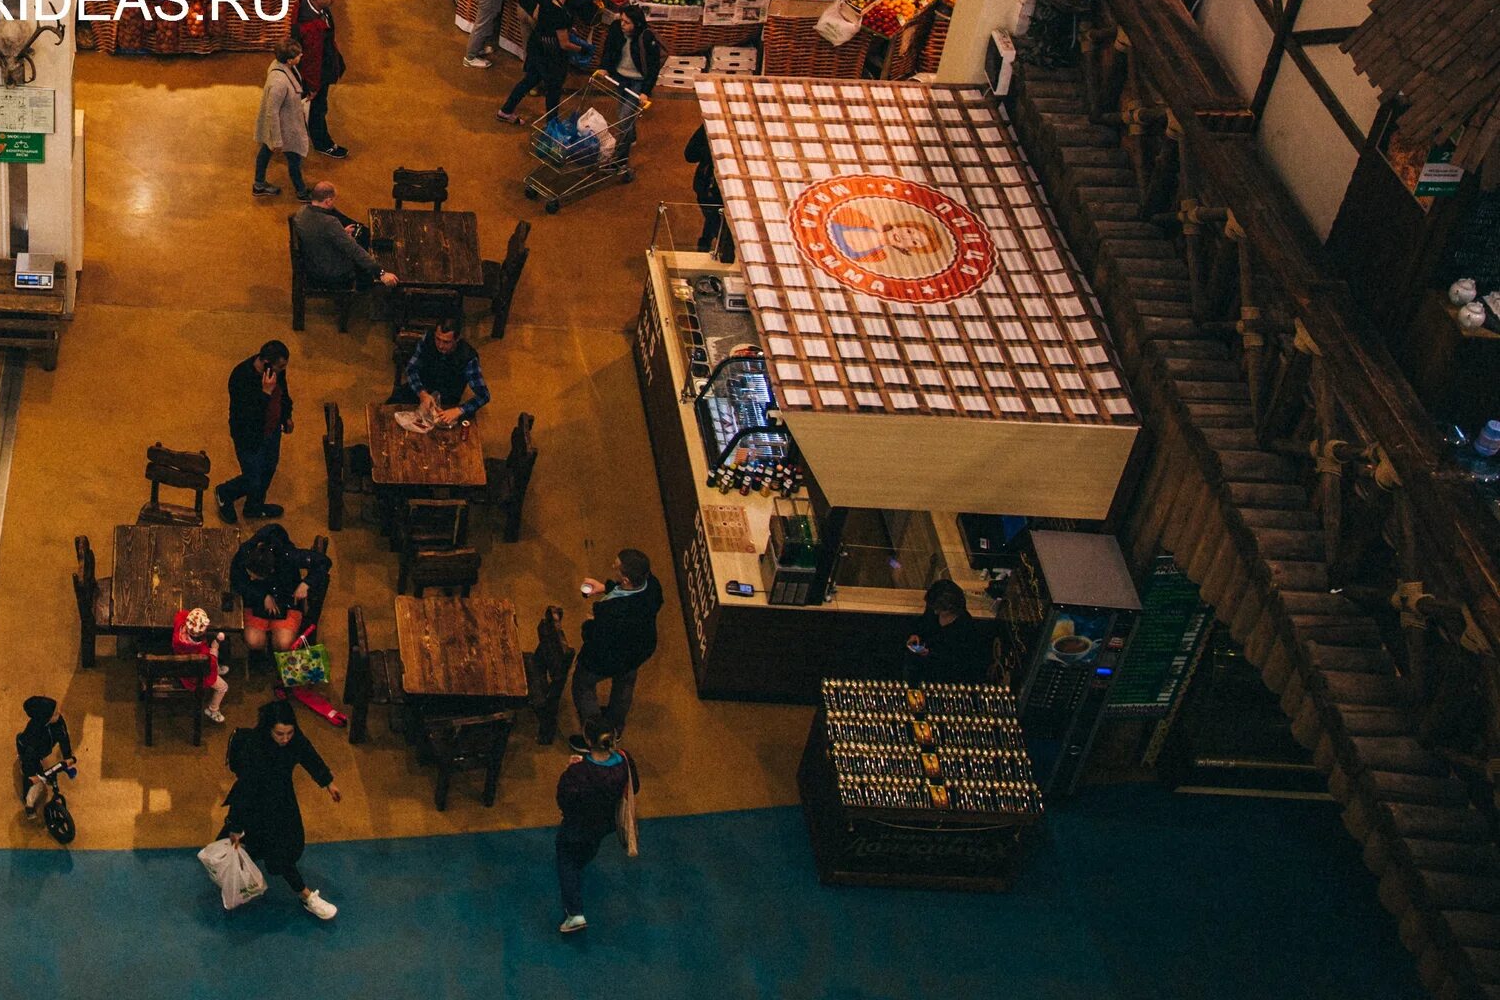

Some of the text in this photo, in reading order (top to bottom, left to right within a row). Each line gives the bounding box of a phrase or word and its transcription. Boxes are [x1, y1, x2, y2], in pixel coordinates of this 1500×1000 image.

[800, 182, 885, 293] МАМА ЭММА
[935, 201, 986, 276] ПИЦЦА
